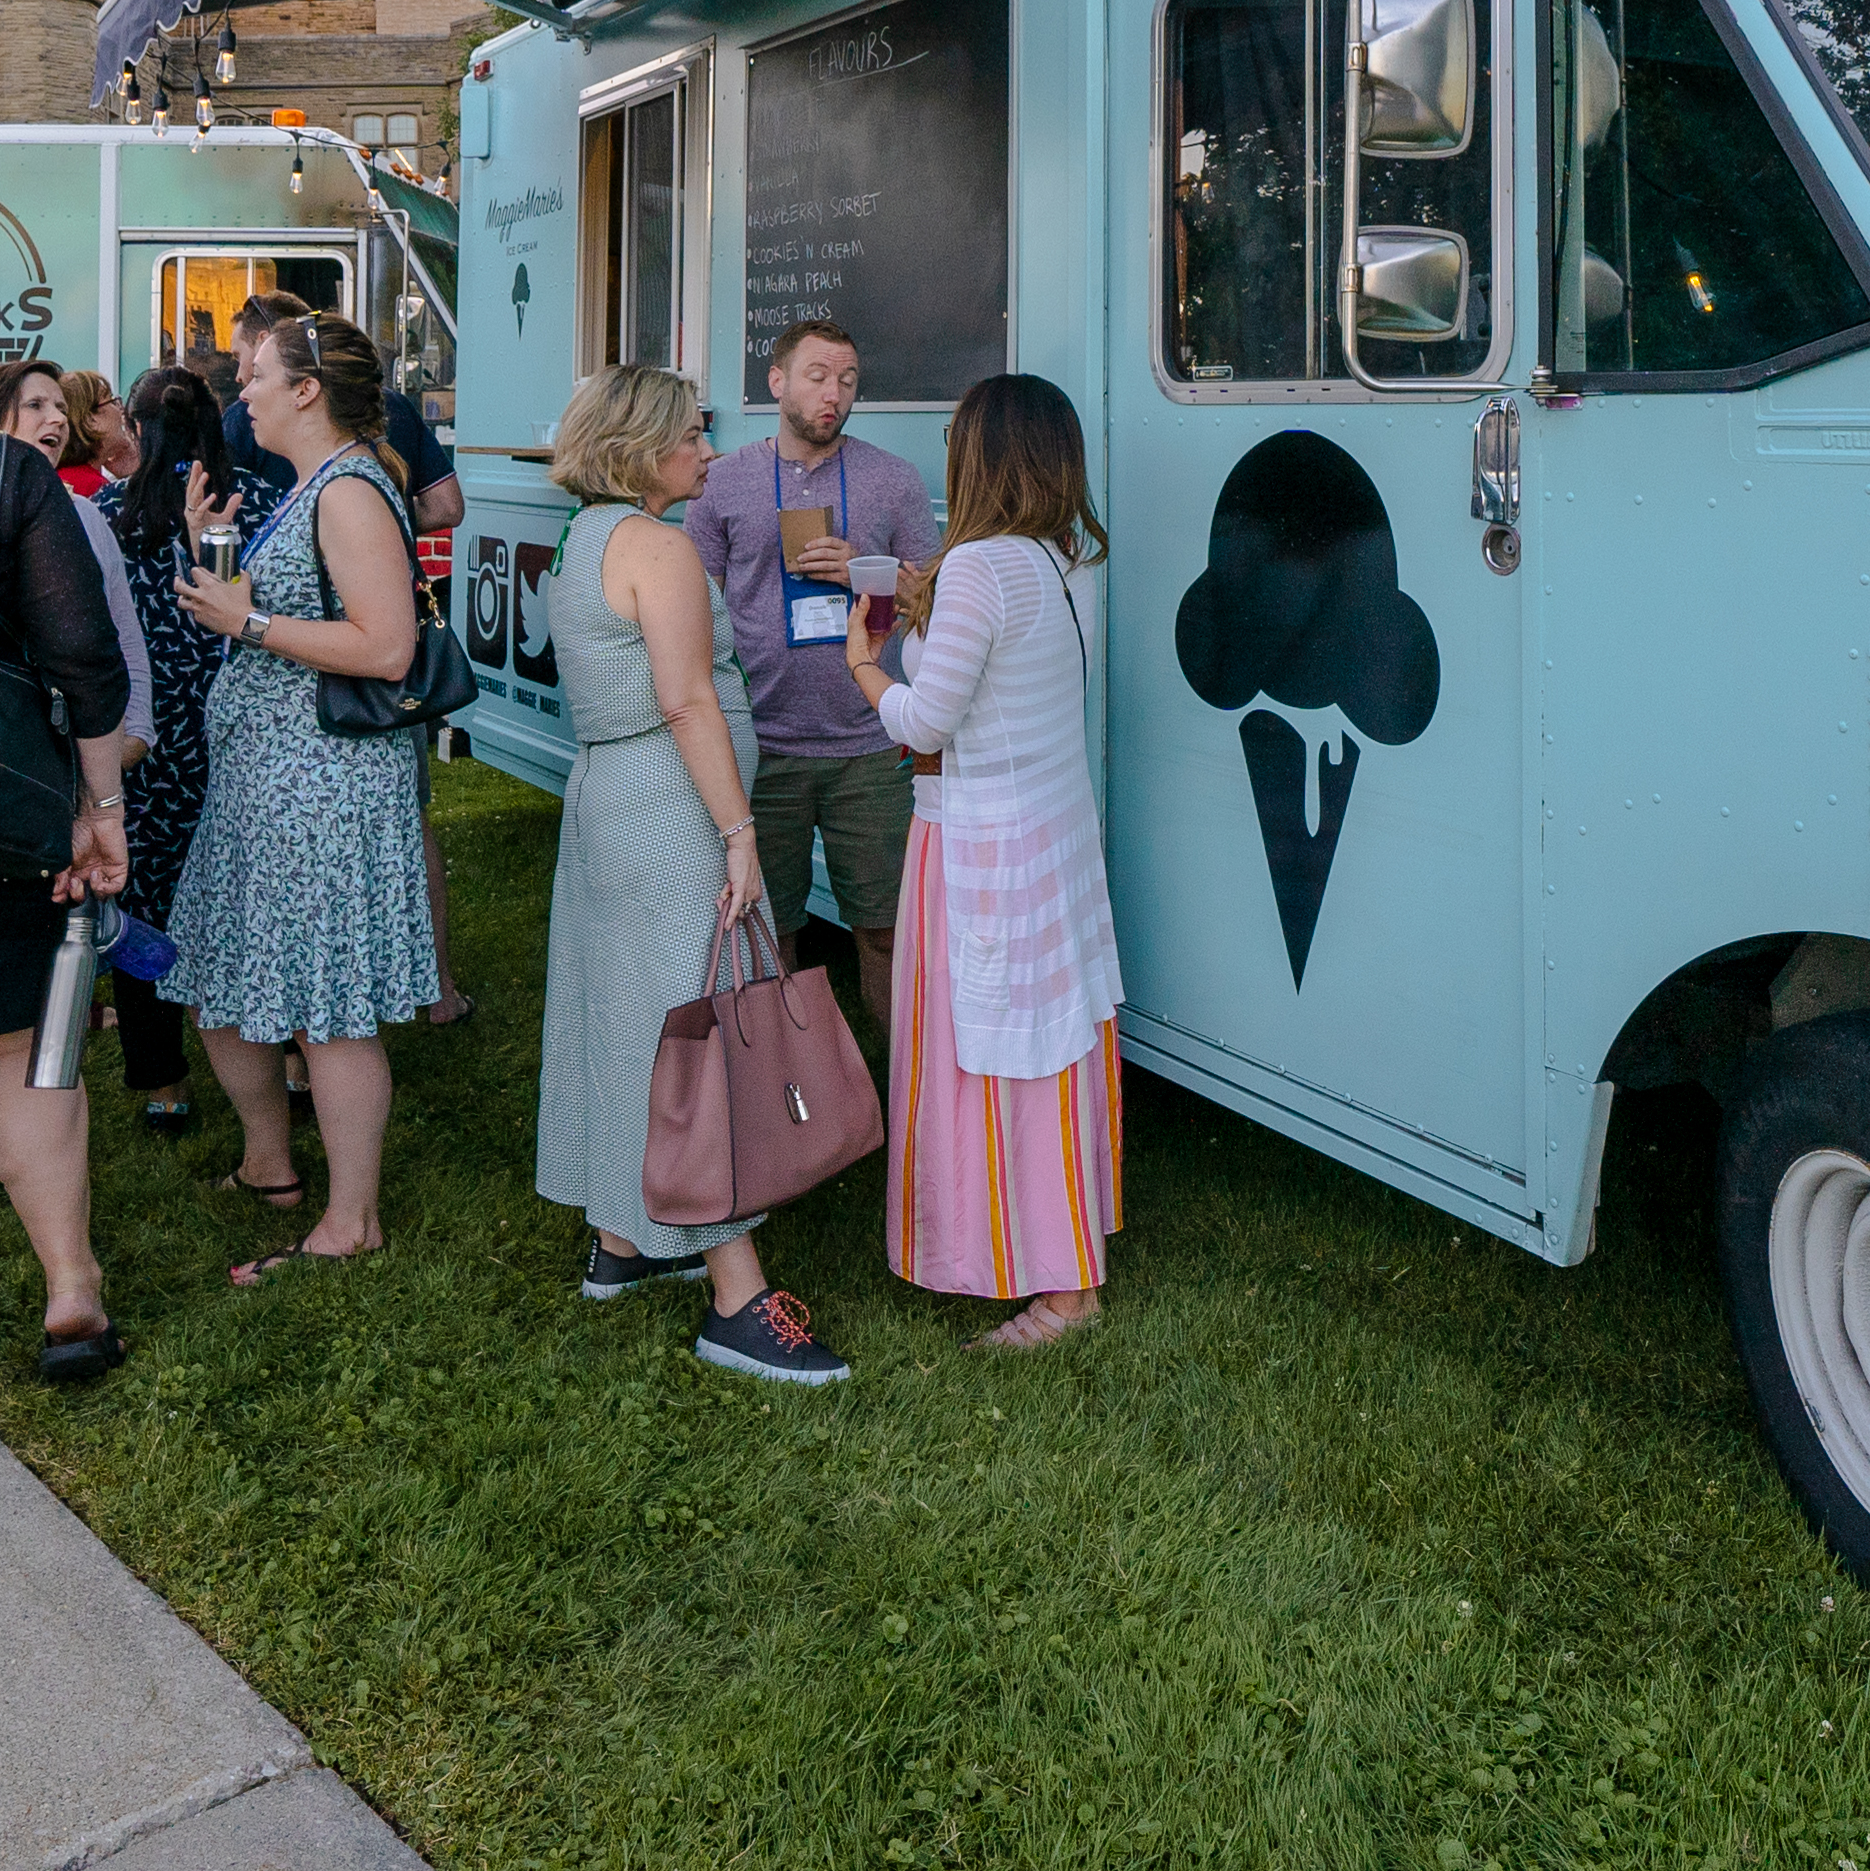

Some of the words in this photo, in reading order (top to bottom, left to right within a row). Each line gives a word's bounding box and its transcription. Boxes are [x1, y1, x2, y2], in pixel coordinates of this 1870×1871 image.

[809, 26, 893, 80] FLAVOURS
[485, 176, 564, 244] MaggieMarie's
[754, 200, 823, 230] RASPBERRY
[830, 191, 882, 218] SORBET
[753, 240, 799, 264] COOKIES
[821, 240, 864, 259] CREAM
[753, 272, 798, 294] NIAGARA
[805, 270, 842, 293] PEACH
[754, 304, 789, 328] MOOSE
[794, 299, 832, 322] TRACKS
